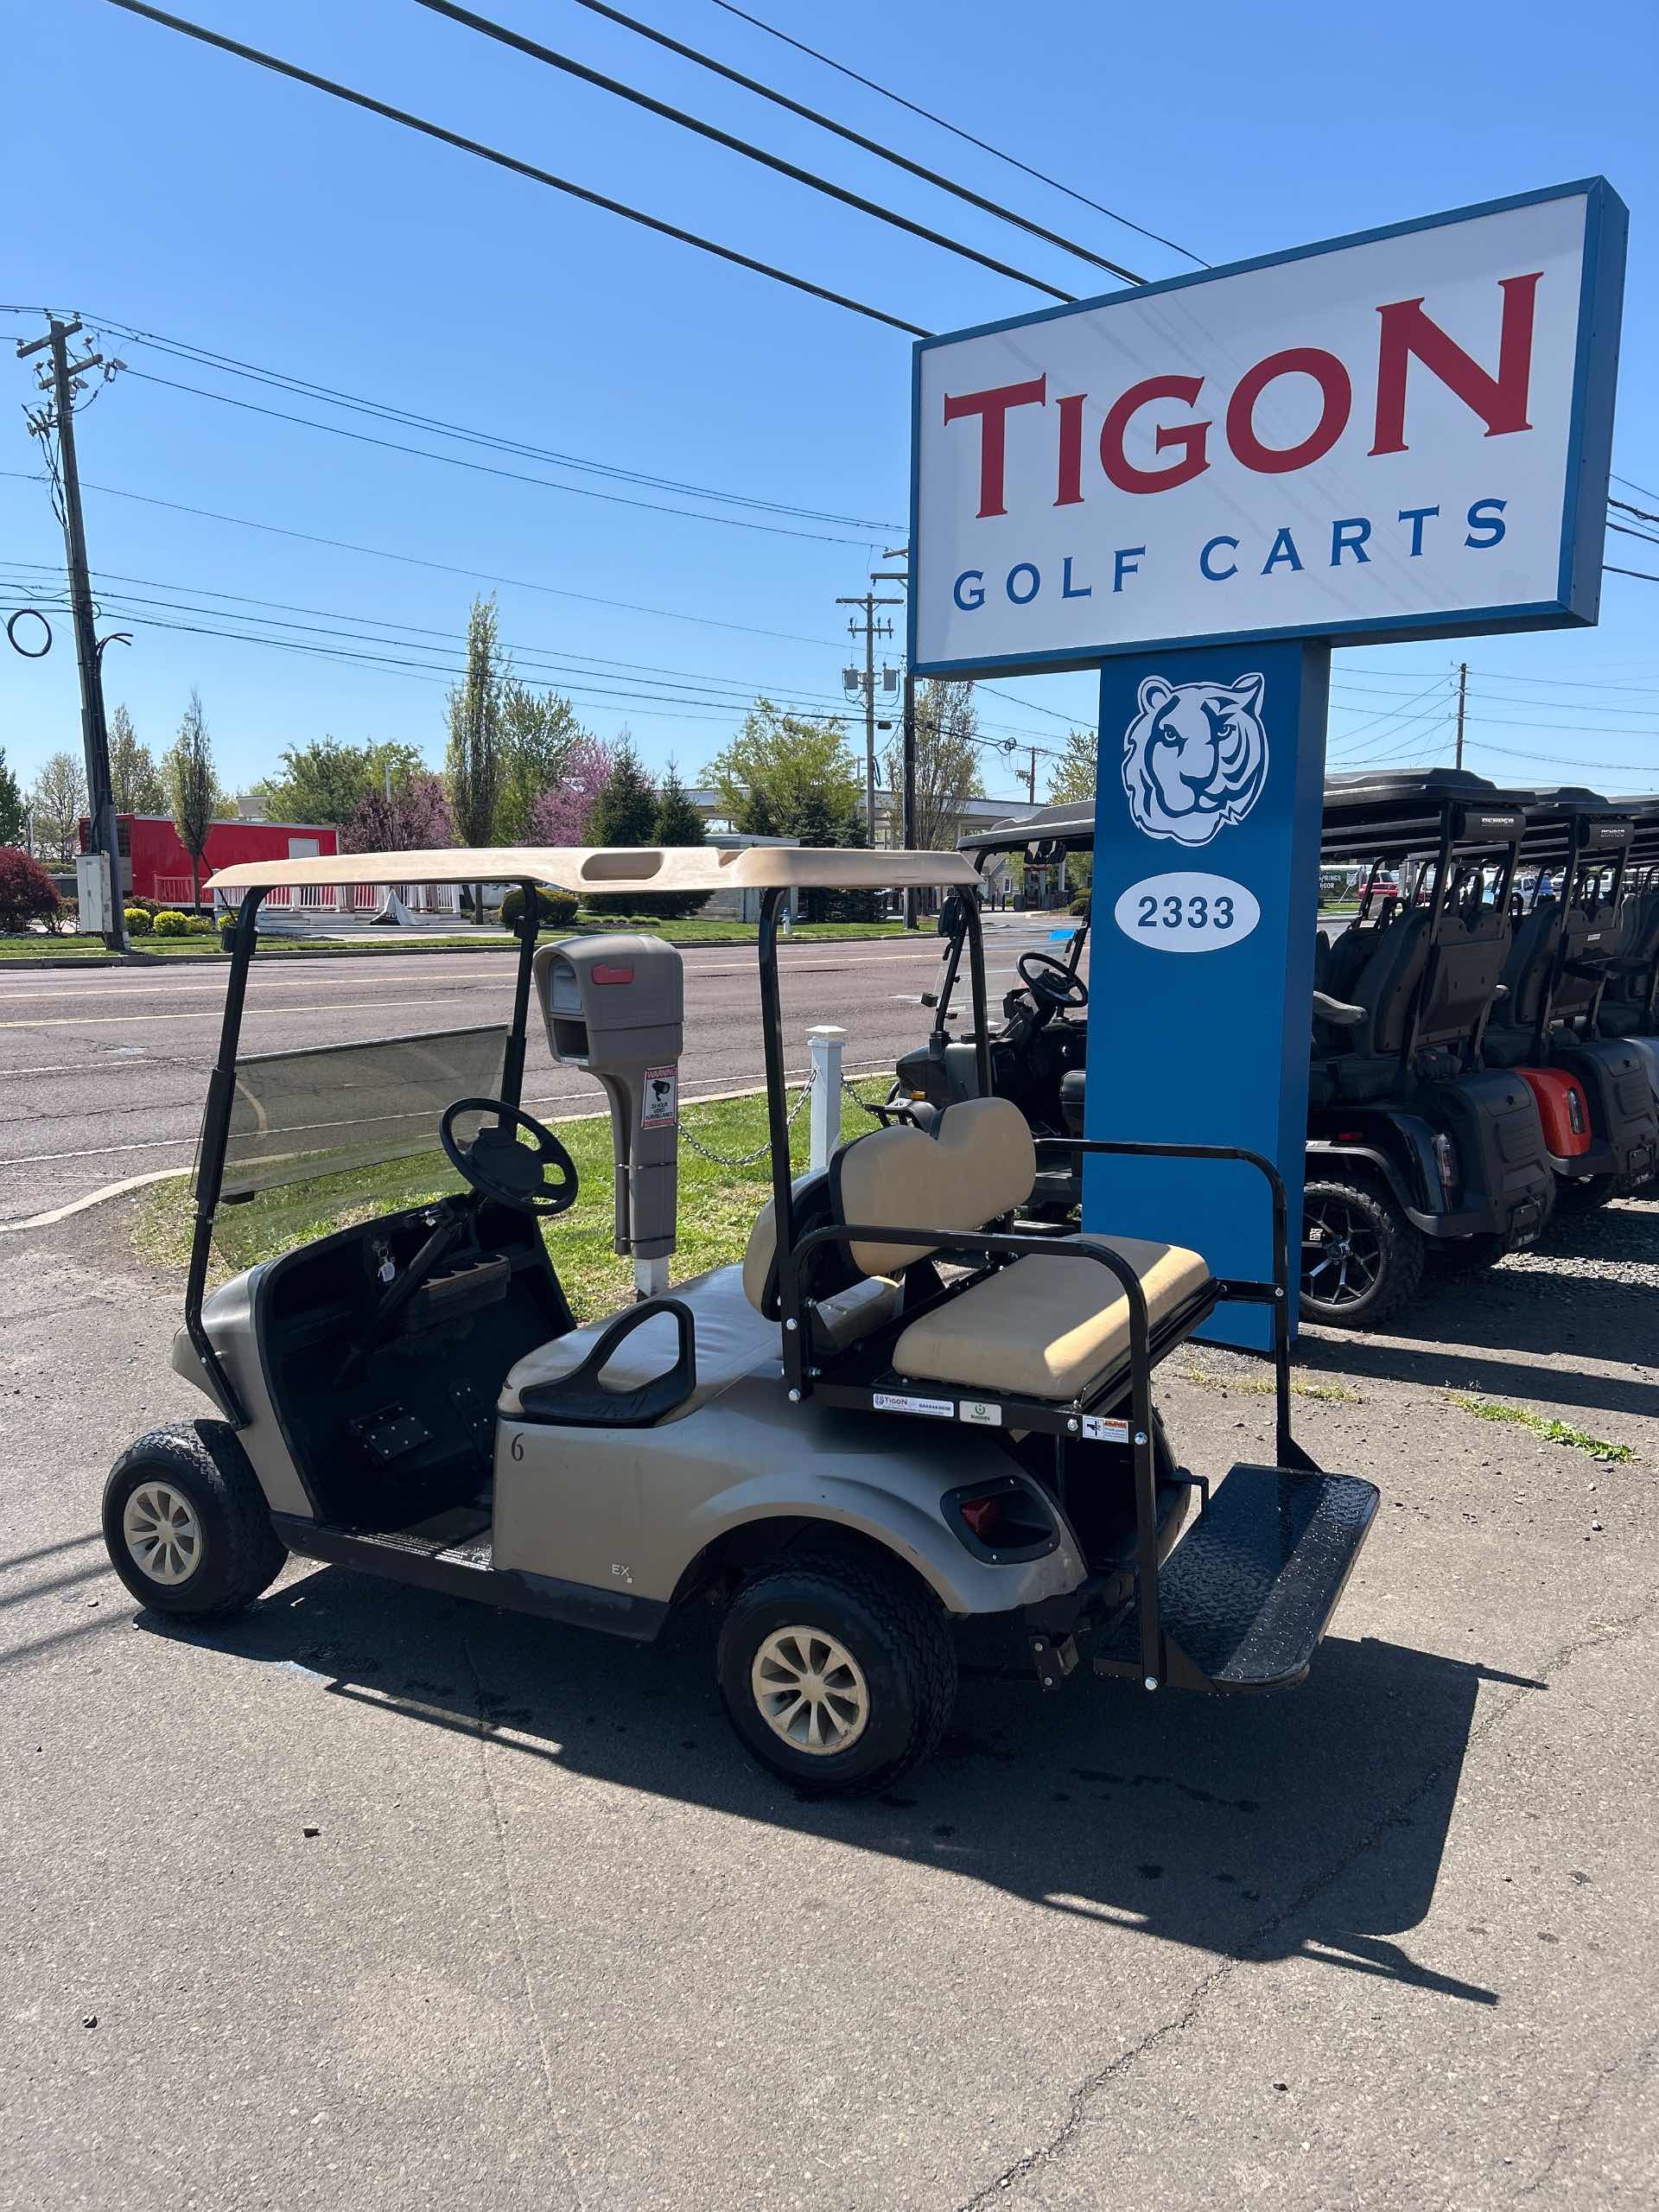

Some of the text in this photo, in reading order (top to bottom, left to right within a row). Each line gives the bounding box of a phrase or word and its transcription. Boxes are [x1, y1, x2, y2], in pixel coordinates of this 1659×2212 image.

[944, 271, 1544, 518] TIGON
[952, 497, 1508, 612] GOLF CARTS
[1137, 895, 1235, 930] 2333
[647, 1068, 678, 1079] WARNING
[885, 1396, 907, 1405] TIGON
[511, 1433, 524, 1461] 6
